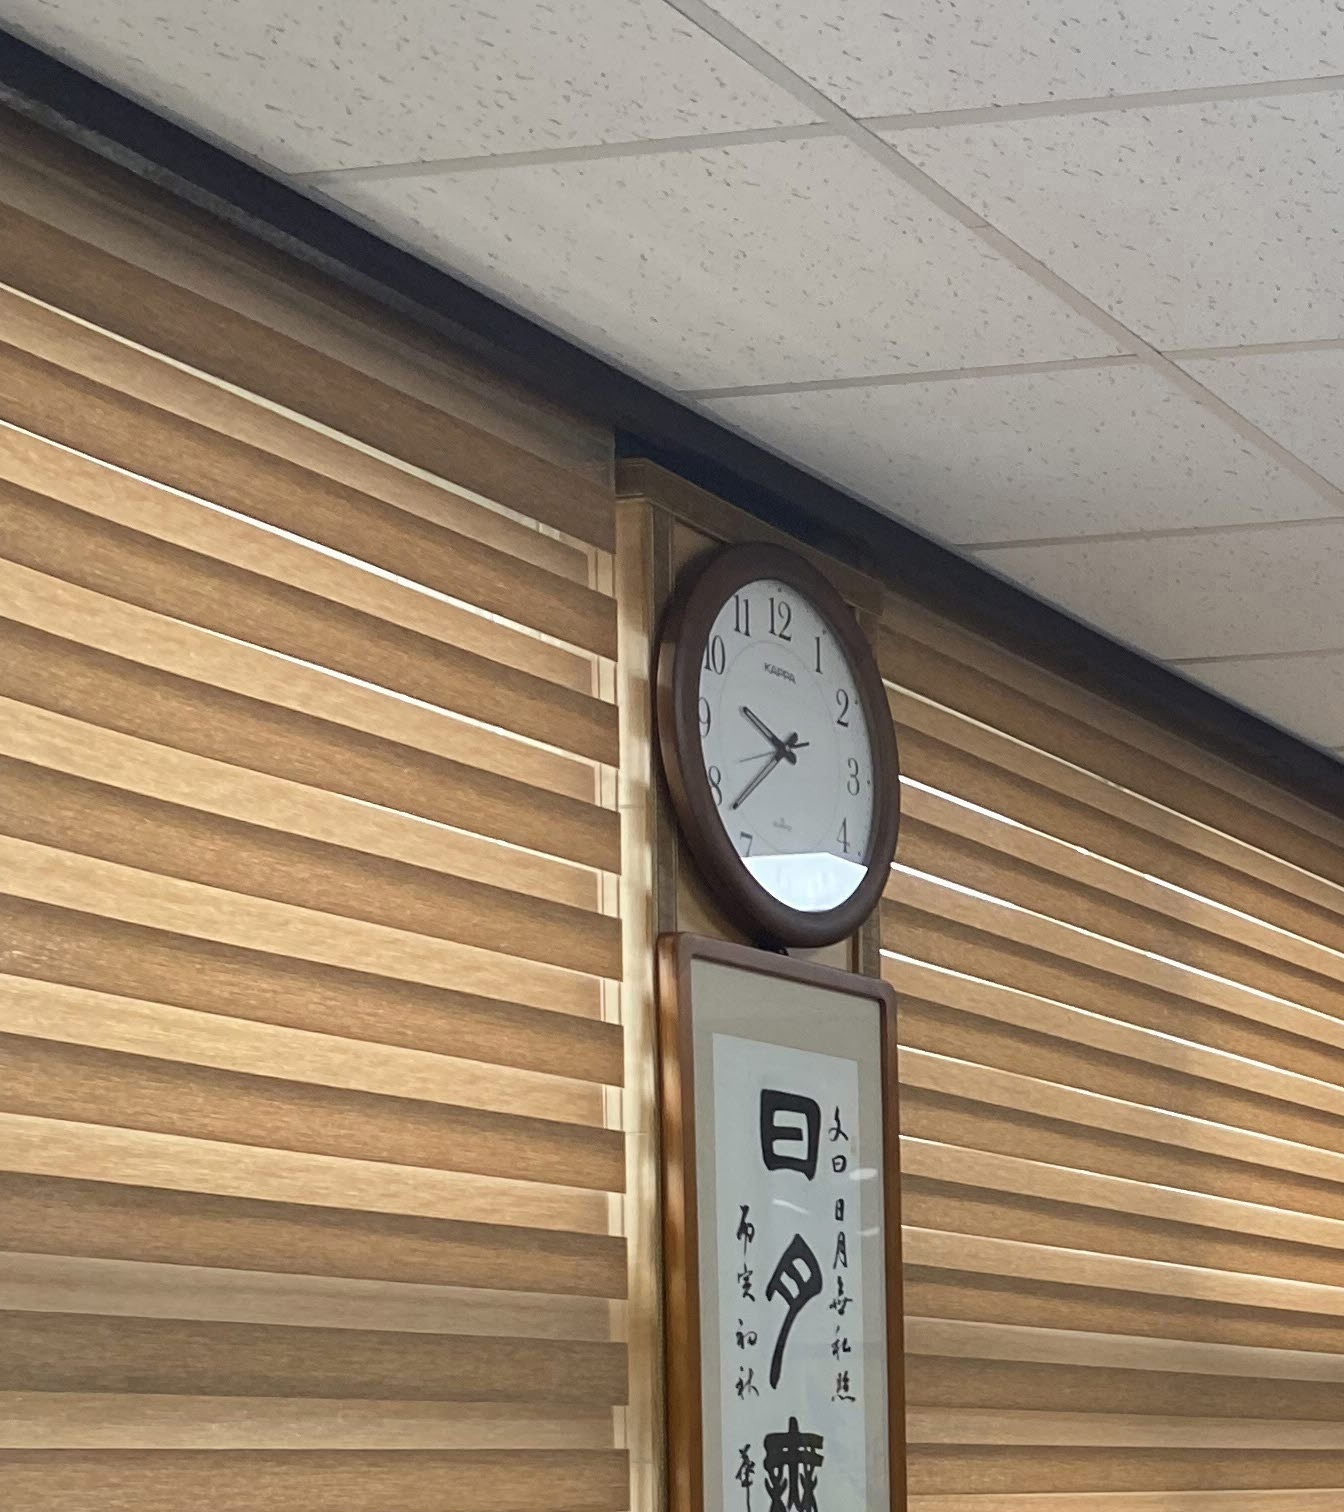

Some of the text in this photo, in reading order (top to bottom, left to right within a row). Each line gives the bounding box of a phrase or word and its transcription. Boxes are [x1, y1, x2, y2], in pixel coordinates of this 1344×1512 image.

[733, 594, 751, 637] 11
[768, 596, 792, 642] 12
[764, 661, 797, 685] KAPPA
[835, 688, 850, 728] 2
[846, 758, 861, 796] 3
[836, 818, 852, 854] 4
